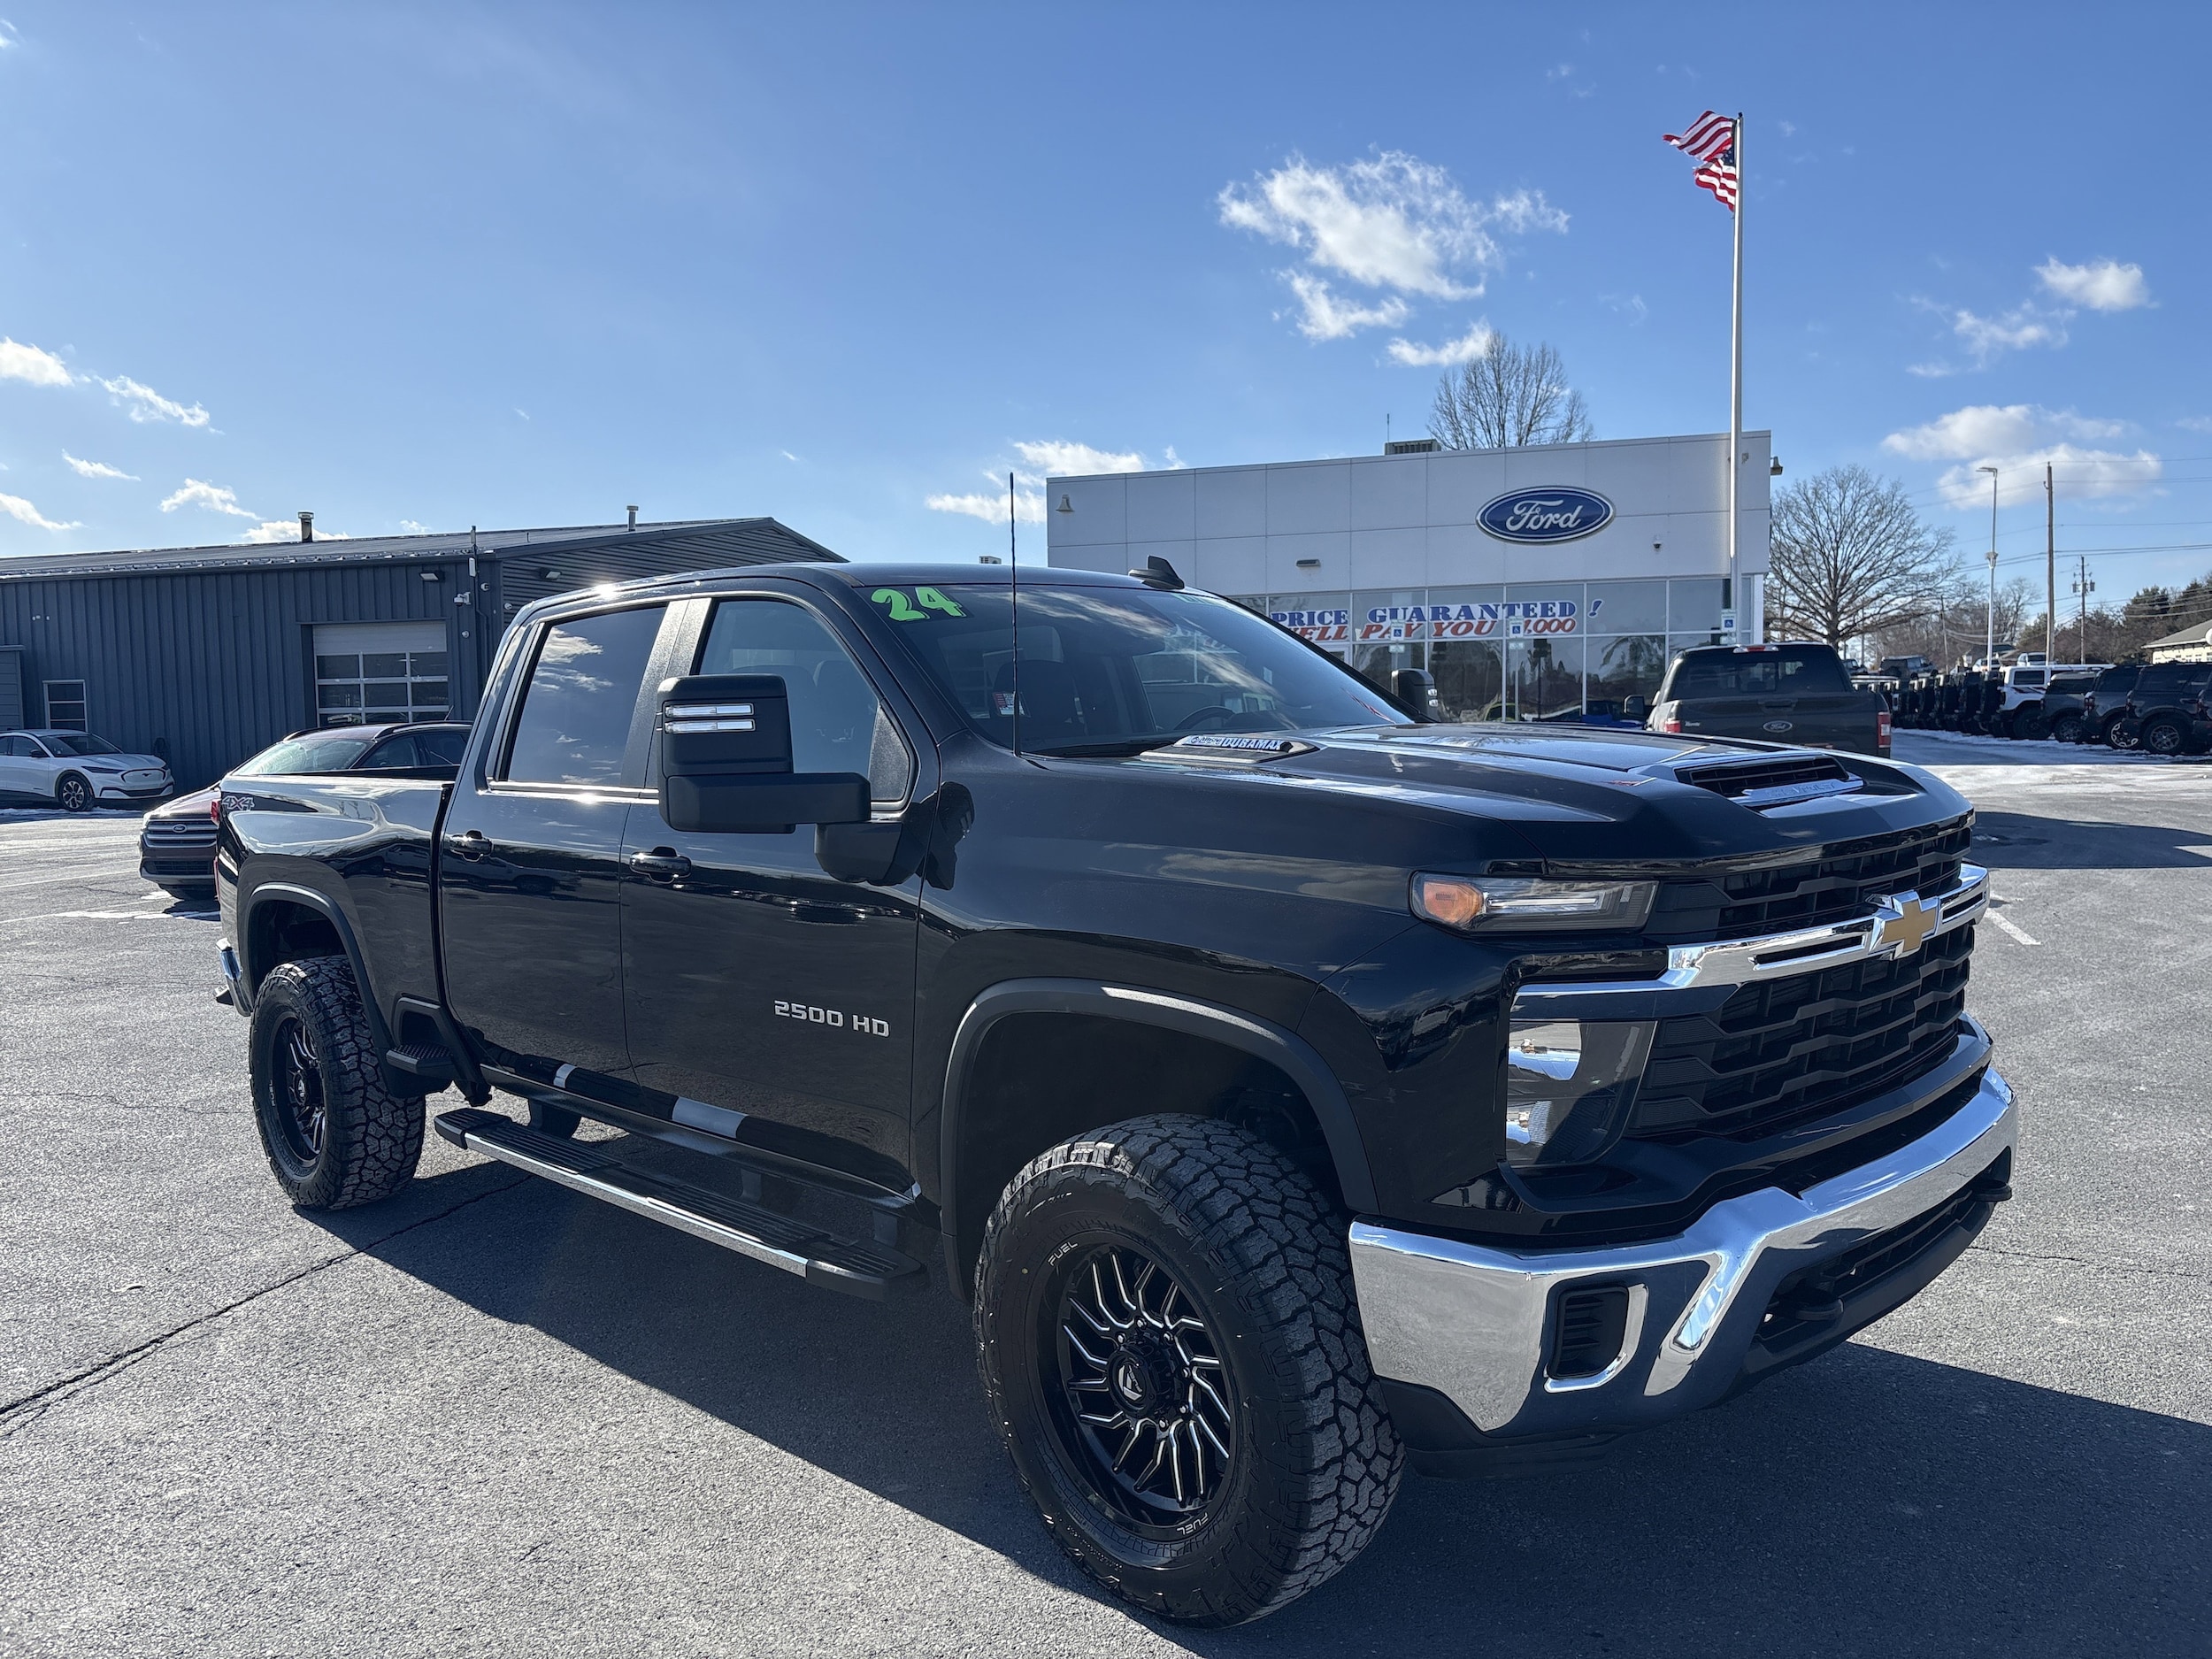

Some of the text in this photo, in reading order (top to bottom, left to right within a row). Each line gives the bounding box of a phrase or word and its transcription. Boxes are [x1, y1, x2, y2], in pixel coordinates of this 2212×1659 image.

[1506, 499, 1584, 532] Ford
[871, 587, 967, 621] 24
[1271, 610, 1348, 626] PRICE
[1368, 602, 1576, 624] GUARANTEED
[1432, 620, 1497, 636] YOU
[1221, 736, 1283, 750] DURAMAX
[774, 1000, 889, 1038] 2500 HD
[1047, 1240, 1079, 1266] FUEL
[1176, 1511, 1209, 1535] FUEL
